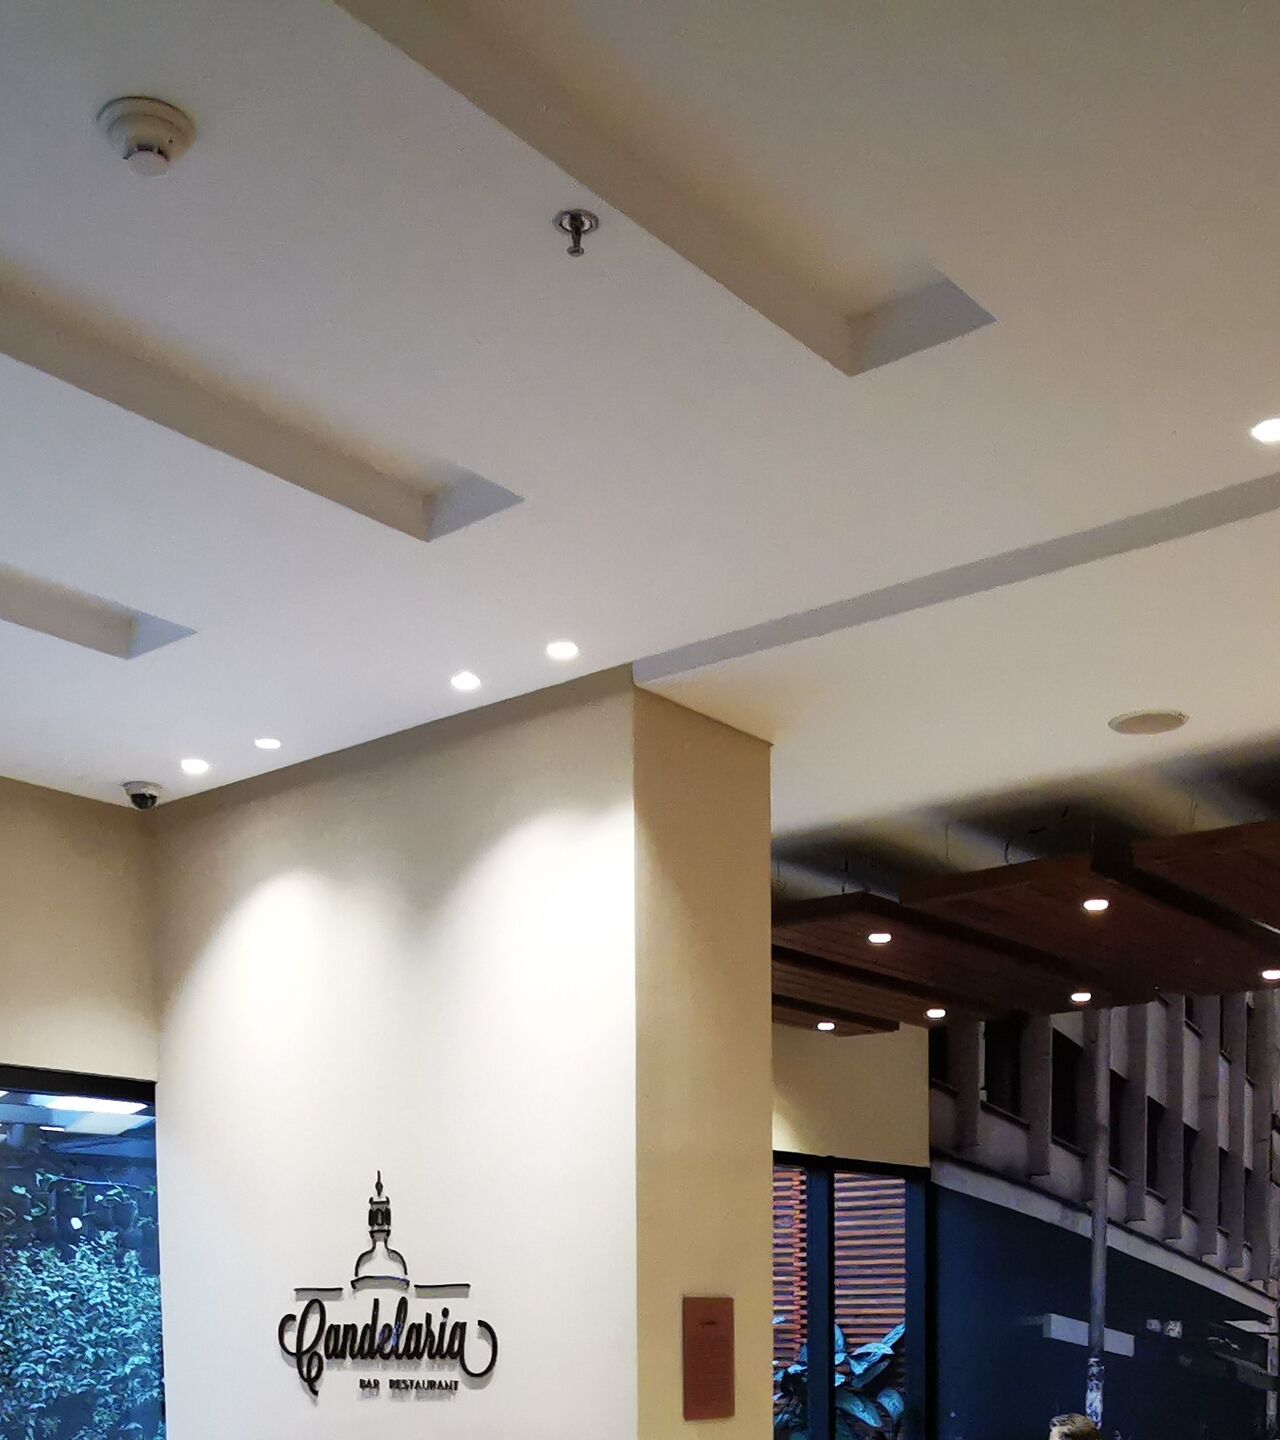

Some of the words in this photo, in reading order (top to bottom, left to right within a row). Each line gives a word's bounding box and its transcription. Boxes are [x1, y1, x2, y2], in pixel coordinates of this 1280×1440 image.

[278, 1297, 498, 1396] Candelaria
[359, 1378, 380, 1390] BAR
[389, 1378, 459, 1391] RESTAURANT
